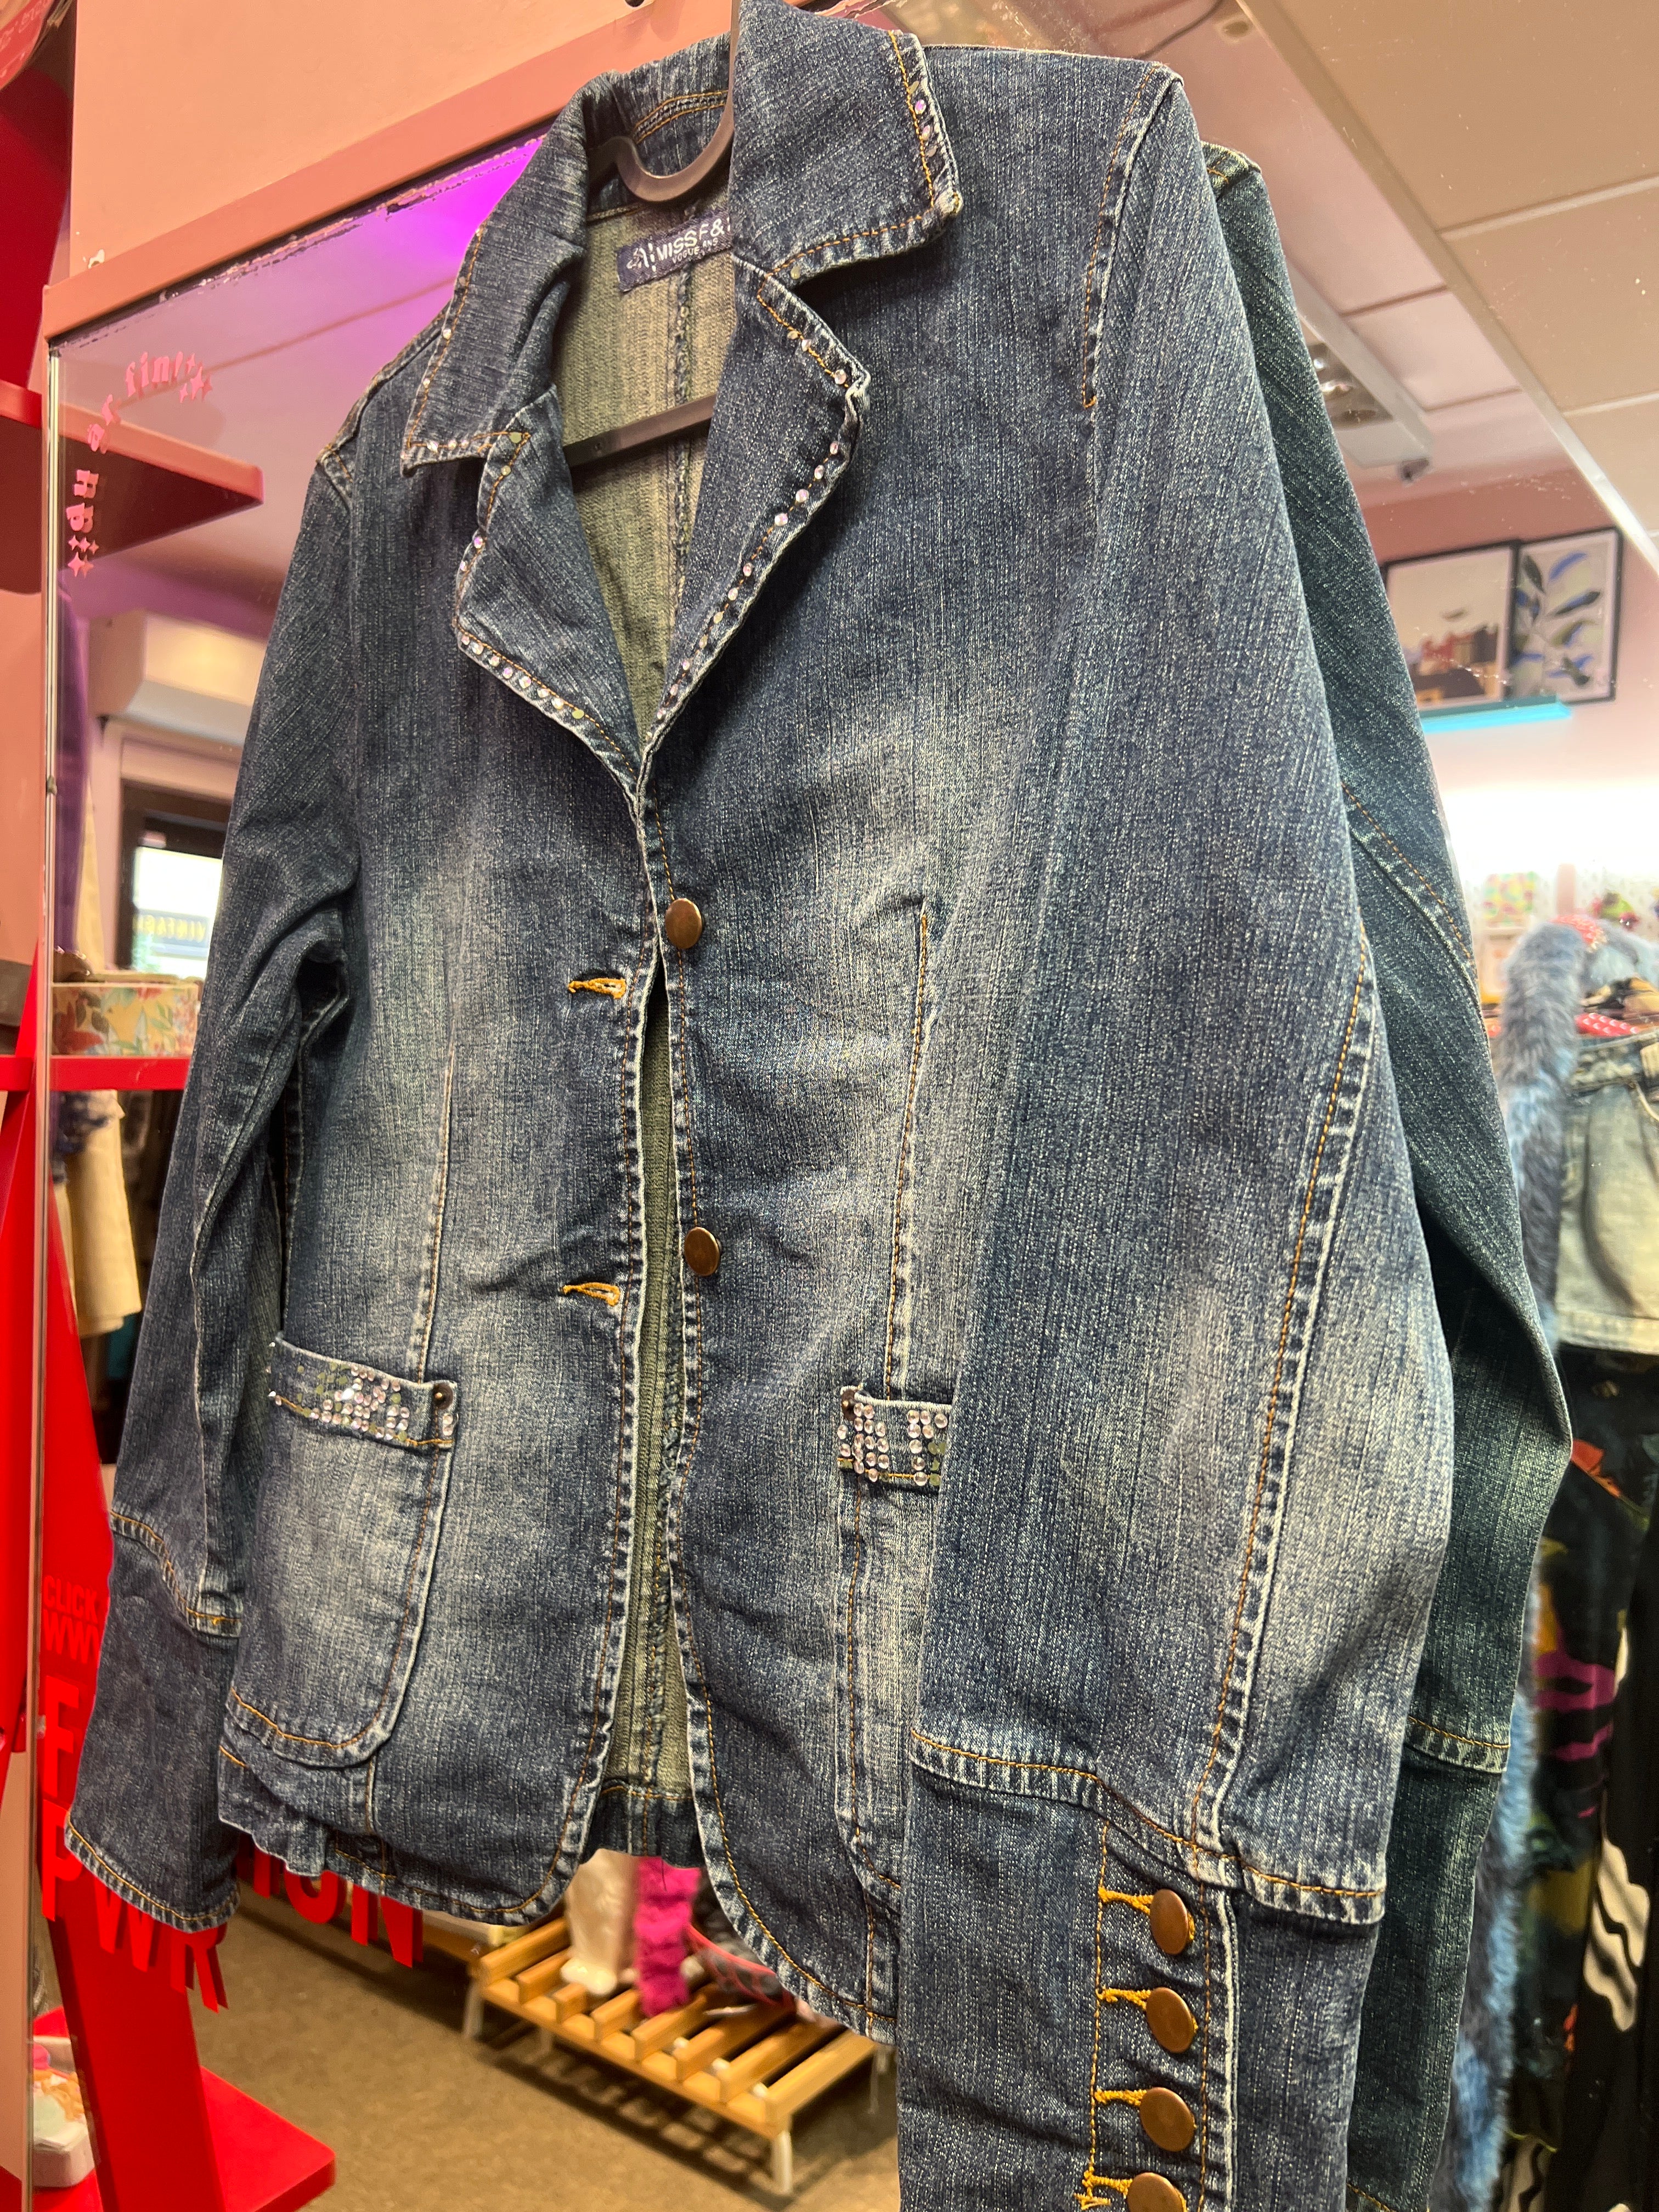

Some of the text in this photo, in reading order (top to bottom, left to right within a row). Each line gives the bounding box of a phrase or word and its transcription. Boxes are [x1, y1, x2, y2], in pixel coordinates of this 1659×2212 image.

[672, 246, 700, 264] VOGUE
[43, 1575, 98, 1624] CLICK
[43, 1609, 103, 1664] WW
